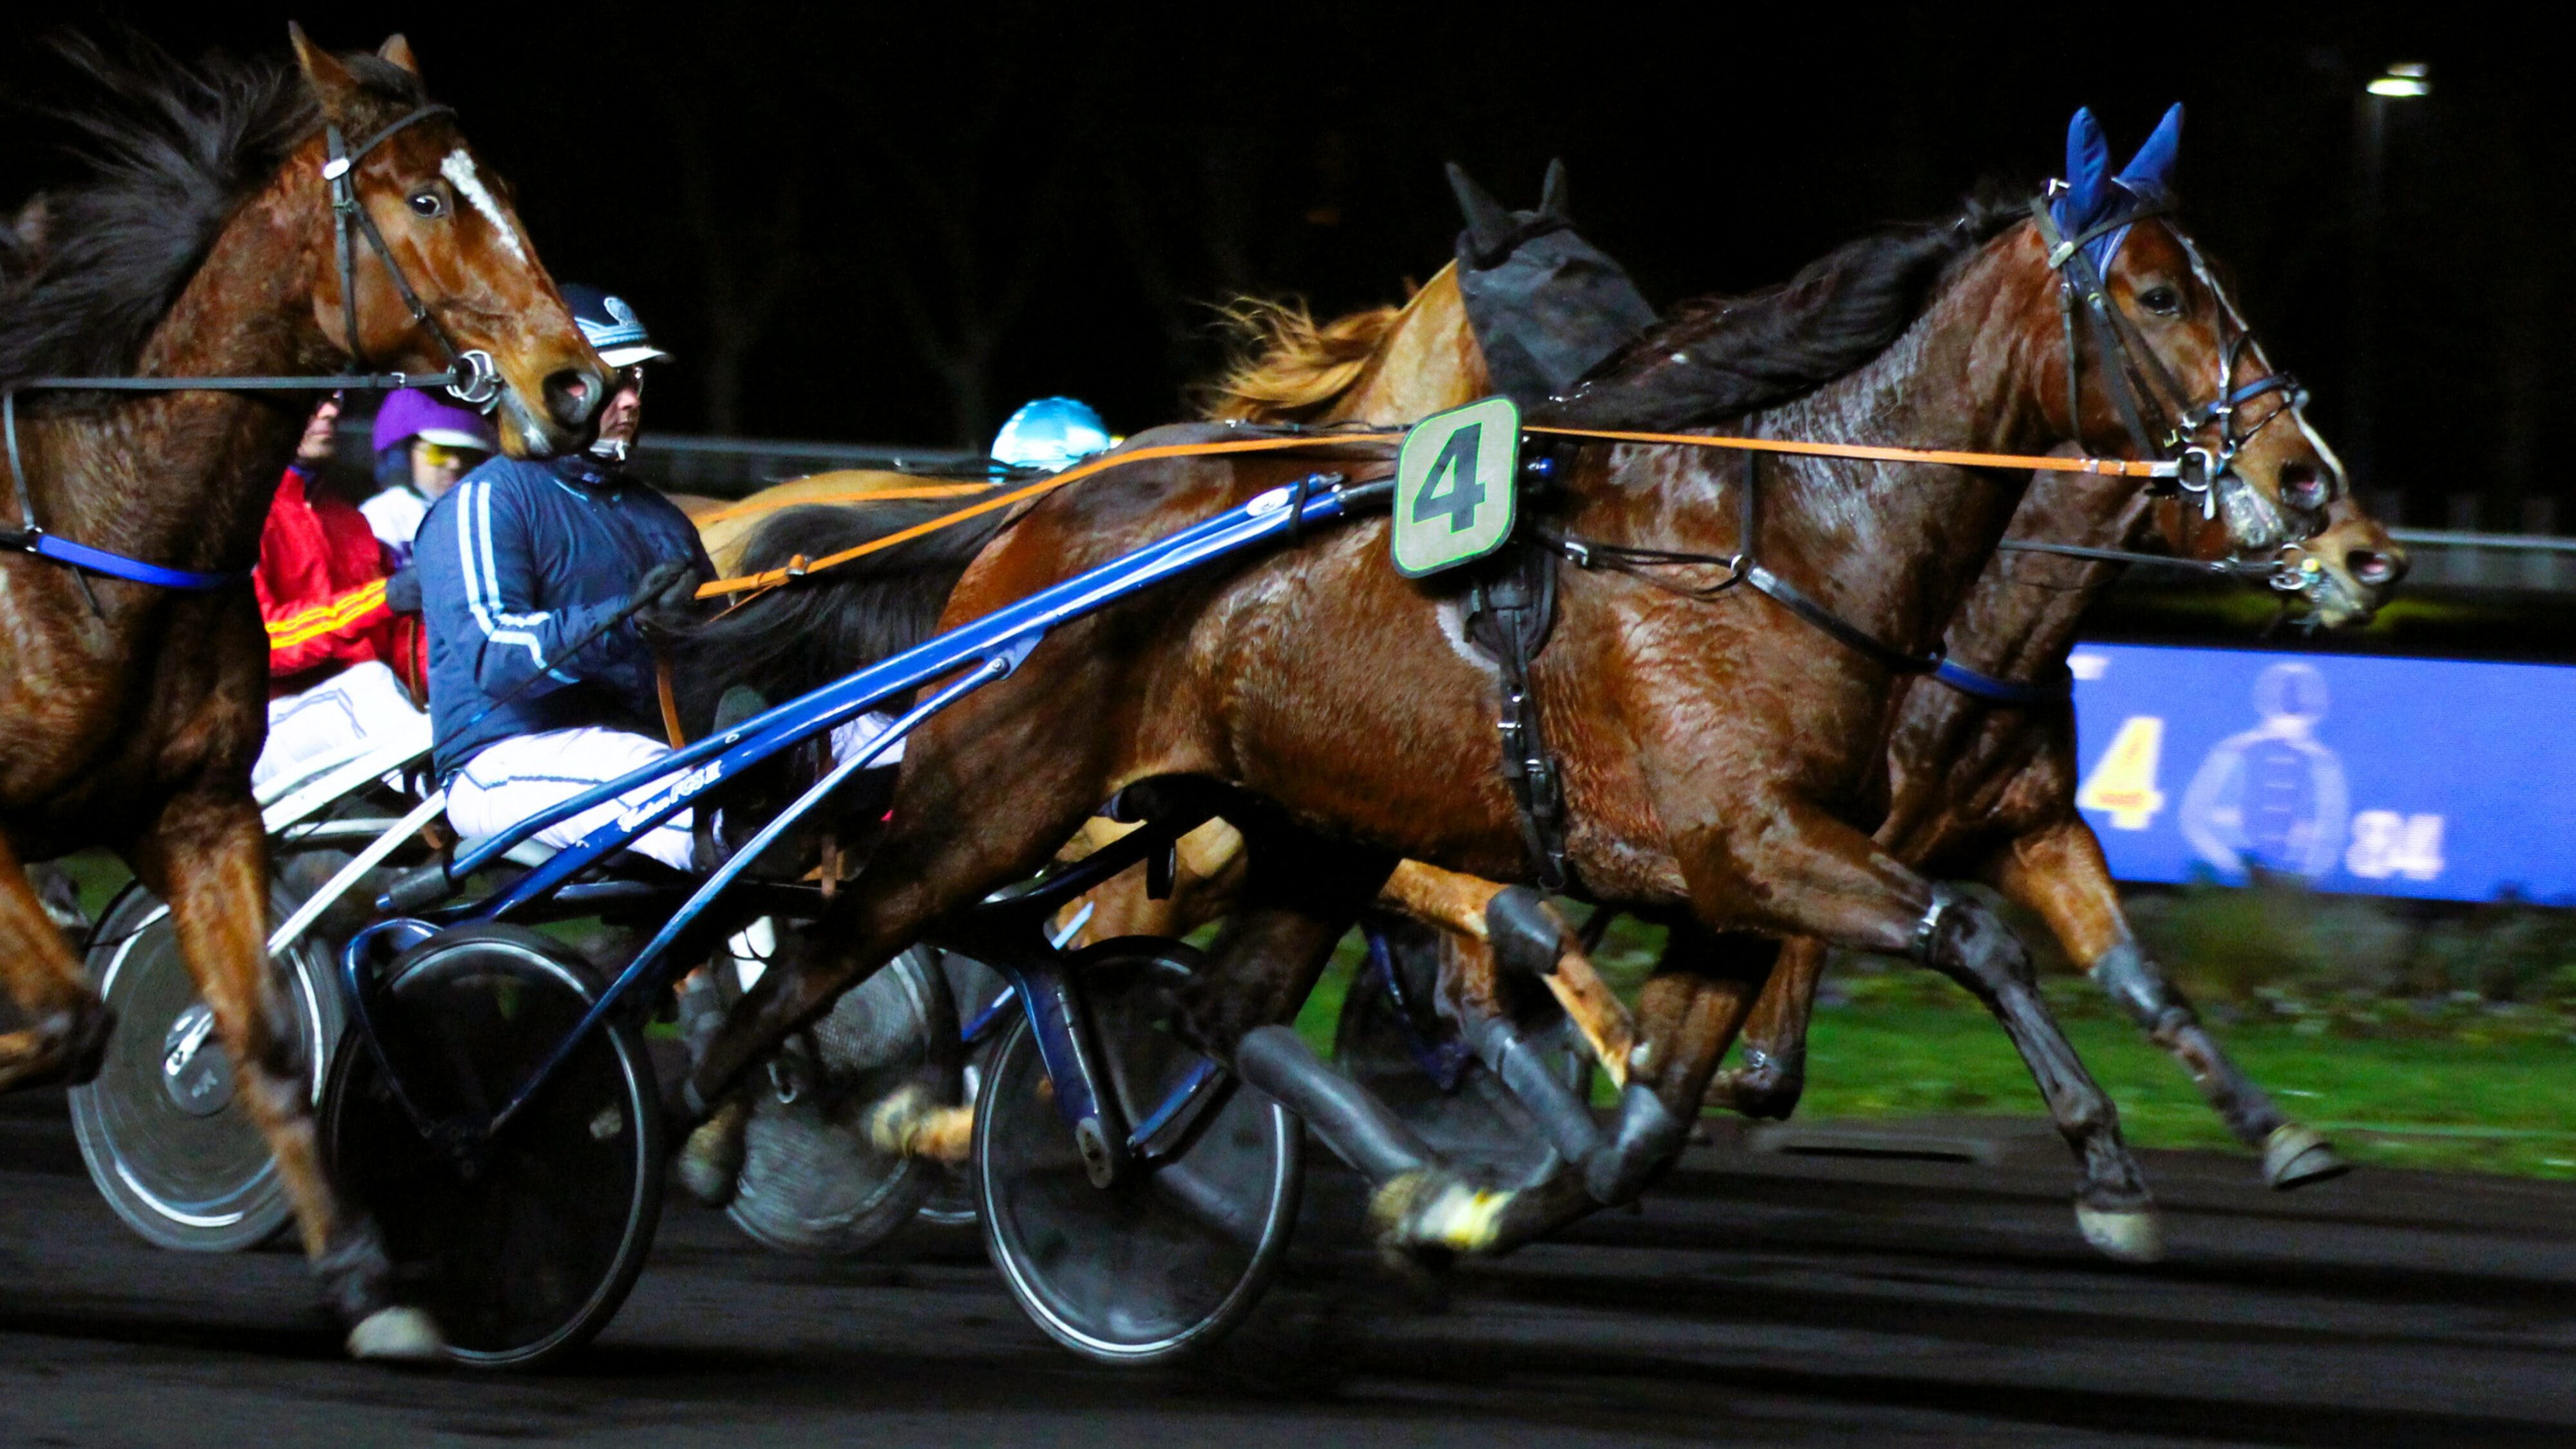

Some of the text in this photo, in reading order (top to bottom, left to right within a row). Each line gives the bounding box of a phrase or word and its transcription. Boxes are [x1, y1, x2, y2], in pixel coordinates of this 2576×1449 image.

[1412, 421, 1486, 535] 4
[2075, 716, 2164, 829] 4
[2345, 810, 2446, 880] 84
